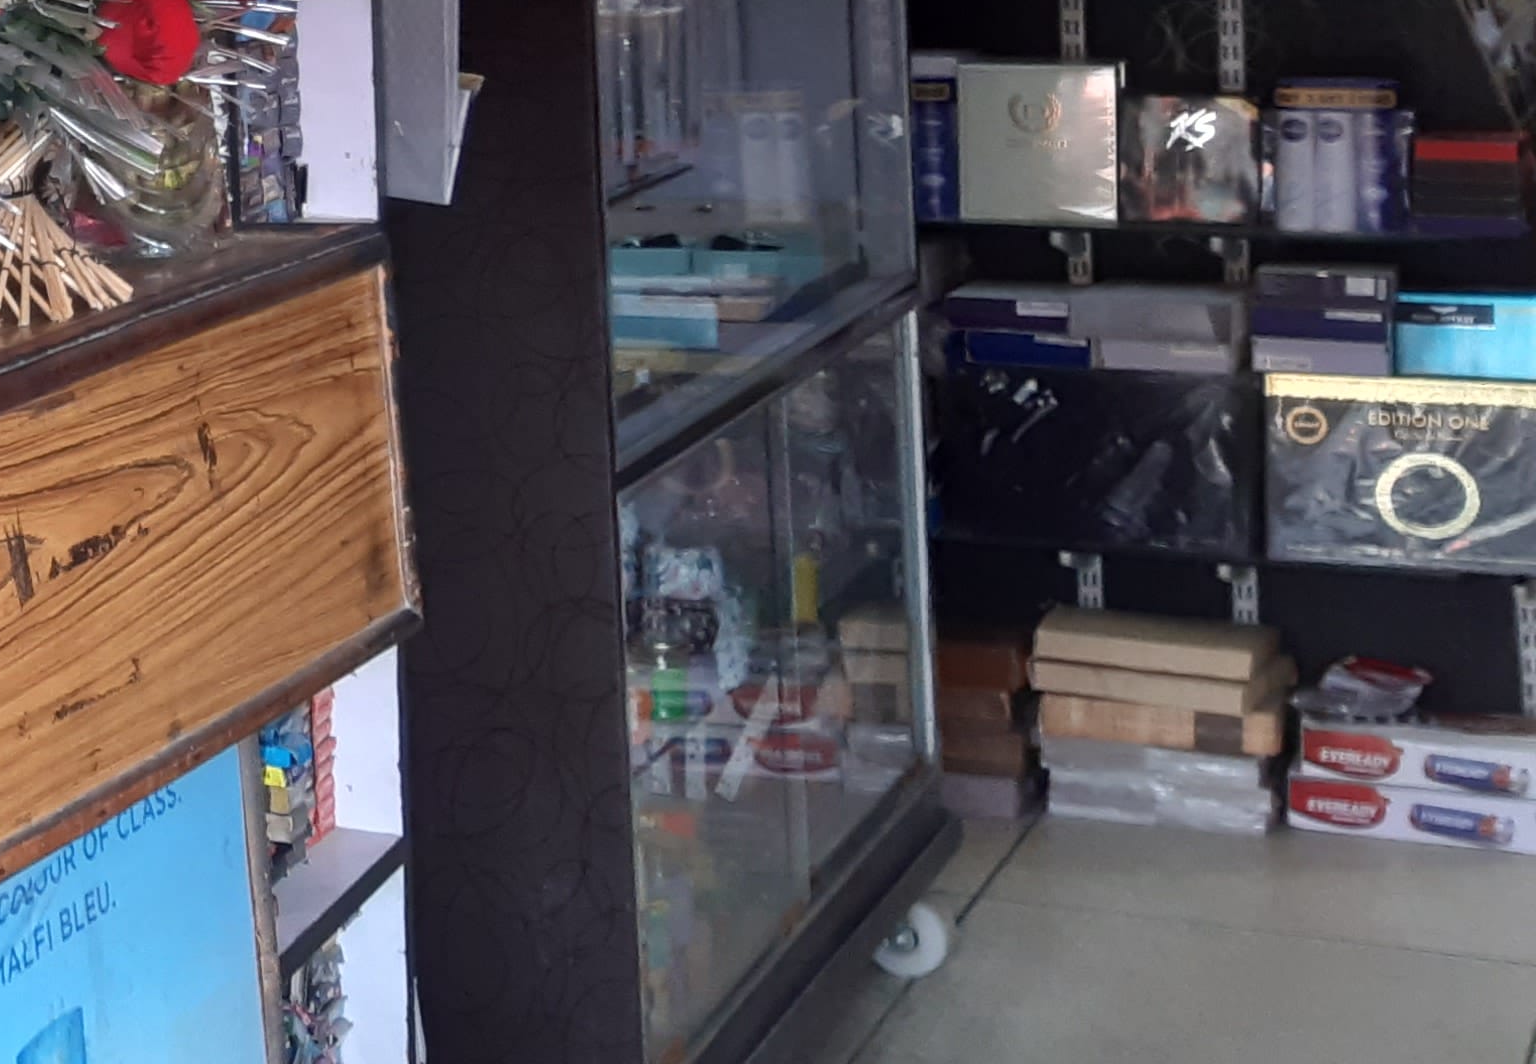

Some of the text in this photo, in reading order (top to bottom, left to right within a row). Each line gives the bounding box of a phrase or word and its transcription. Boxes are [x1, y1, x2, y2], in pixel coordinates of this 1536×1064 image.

[1368, 409, 1490, 432] EDITION ONE
[83, 824, 108, 860] OF
[116, 785, 182, 840] CLASS.
[59, 881, 116, 942] BLEU.
